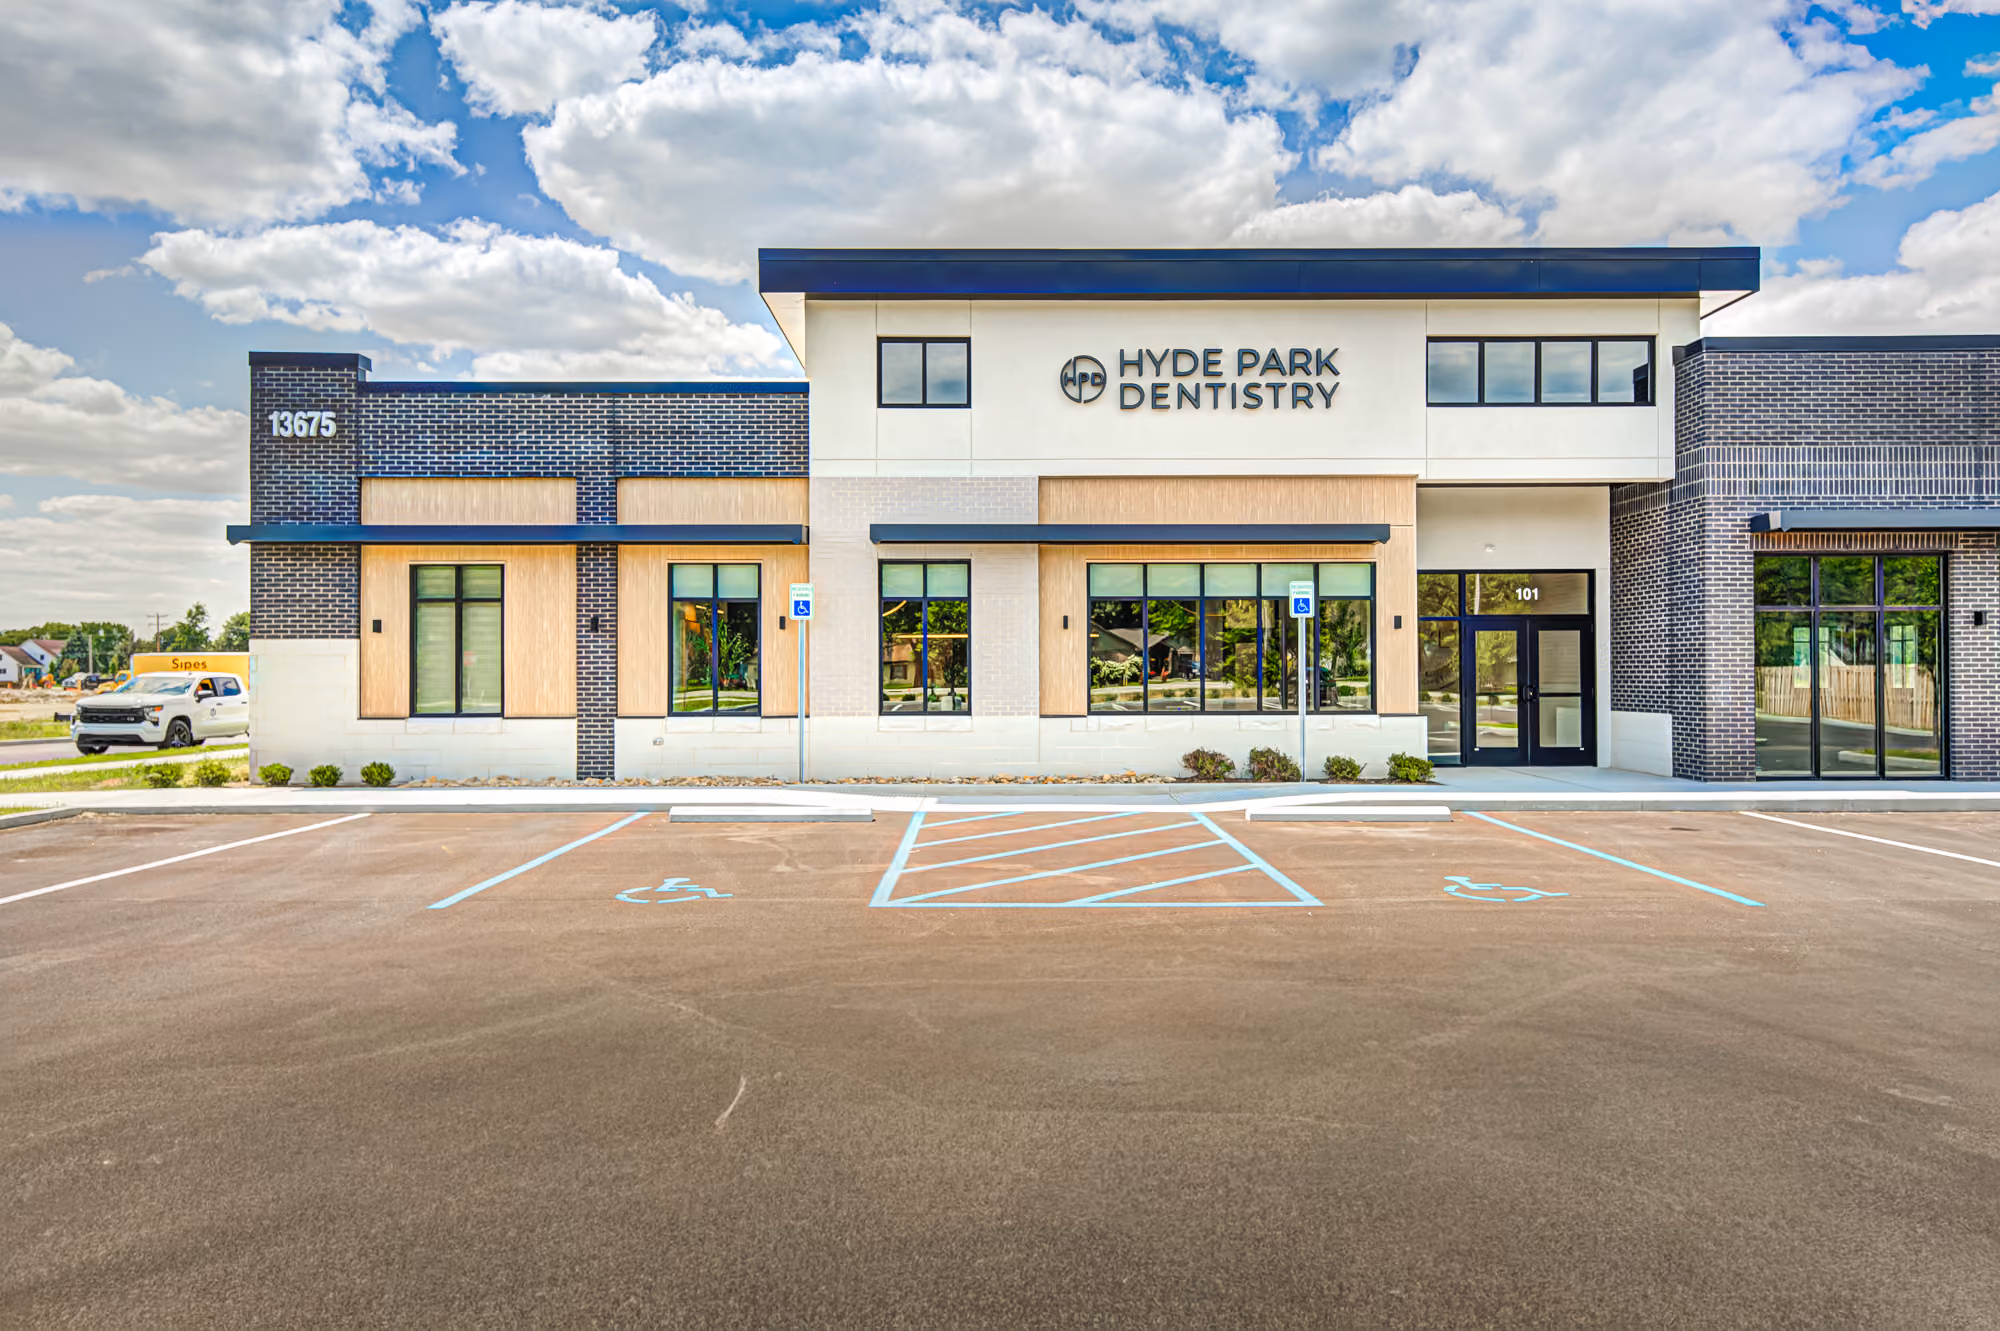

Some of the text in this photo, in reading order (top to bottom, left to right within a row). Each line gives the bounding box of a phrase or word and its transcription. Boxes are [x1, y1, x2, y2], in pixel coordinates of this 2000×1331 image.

[1119, 347, 1340, 377] HYDE PARK
[1119, 382, 1340, 410] DENTISTRY
[268, 410, 337, 438] 13675
[1515, 587, 1539, 601] 101
[172, 658, 208, 671] Sipes
